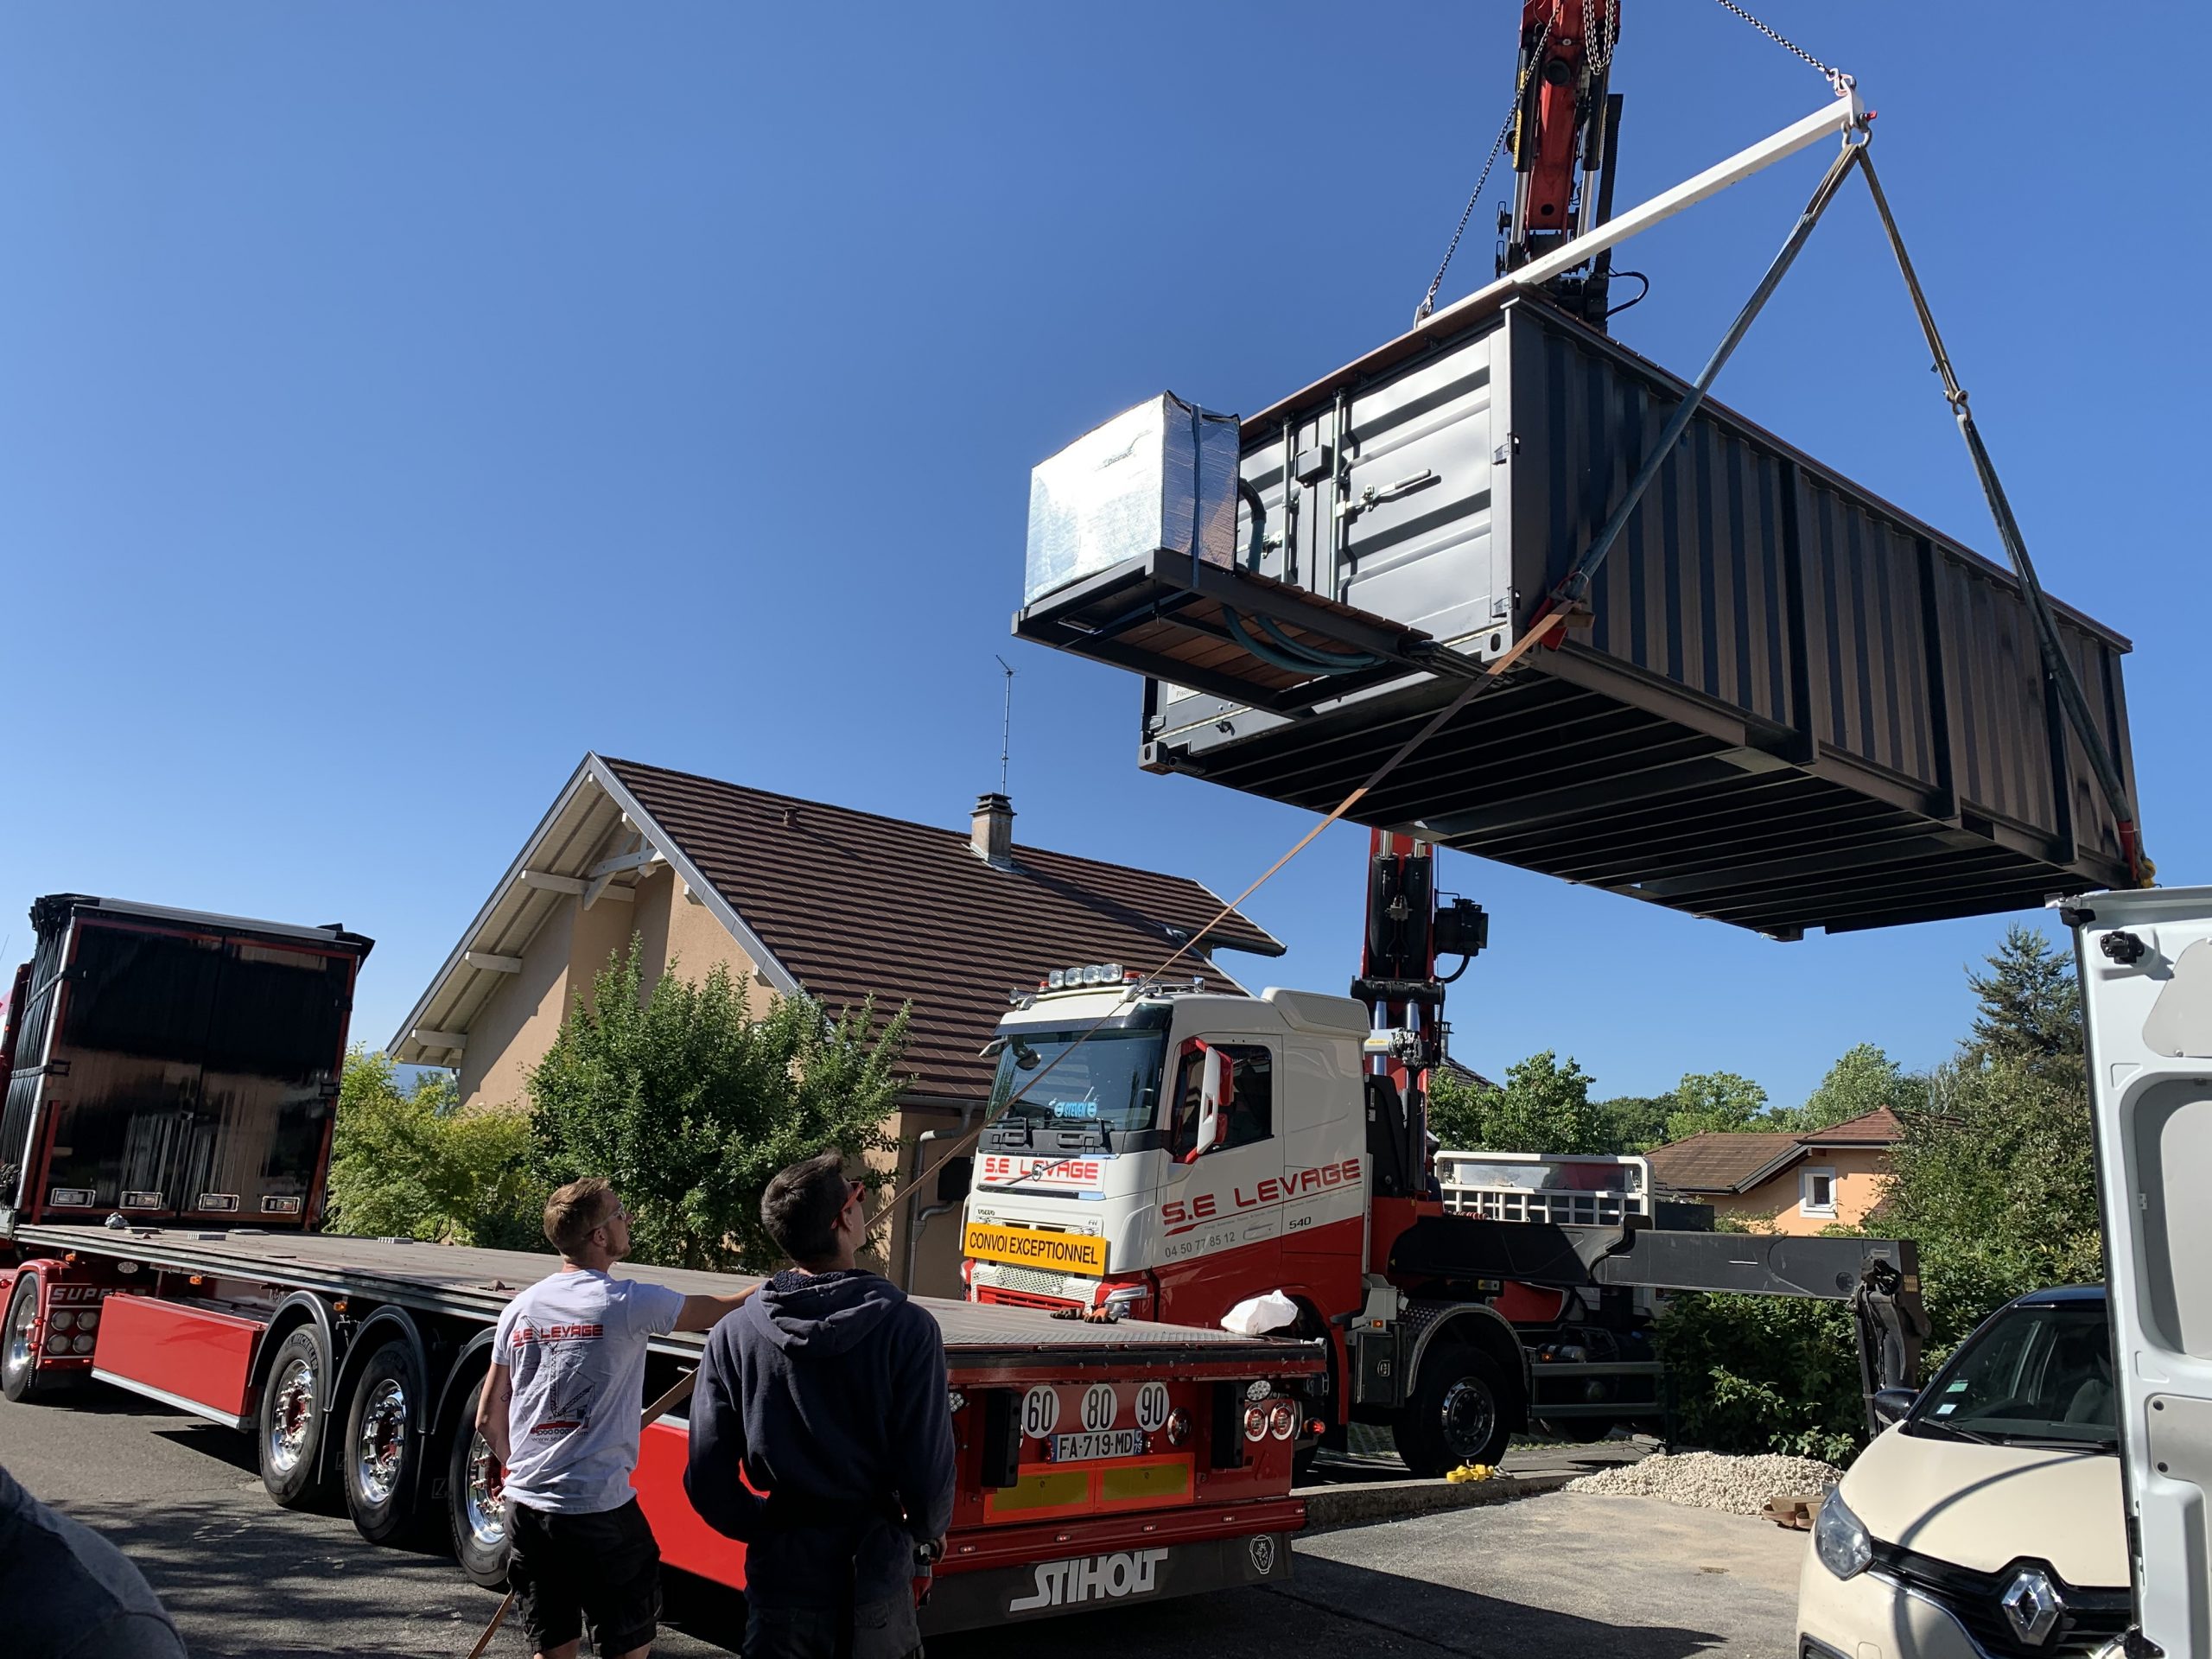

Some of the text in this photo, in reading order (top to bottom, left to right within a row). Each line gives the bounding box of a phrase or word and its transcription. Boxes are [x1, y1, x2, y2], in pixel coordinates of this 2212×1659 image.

[985, 1157, 1009, 1174] S.E
[1161, 1193, 1217, 1225] S.E
[1234, 1158, 1361, 1207] LEVAGE
[1288, 1216, 1312, 1230] 540
[969, 1231, 1099, 1266] CONVOI EXCEPTIONNEL
[1165, 1231, 1236, 1258] 04 50 77 85 12
[540, 1324, 603, 1338] LEVAGE
[1027, 1389, 1054, 1434] 60
[1087, 1388, 1112, 1430] 80
[1141, 1386, 1165, 1427] 90
[1009, 1548, 1168, 1612] STIHOLT
